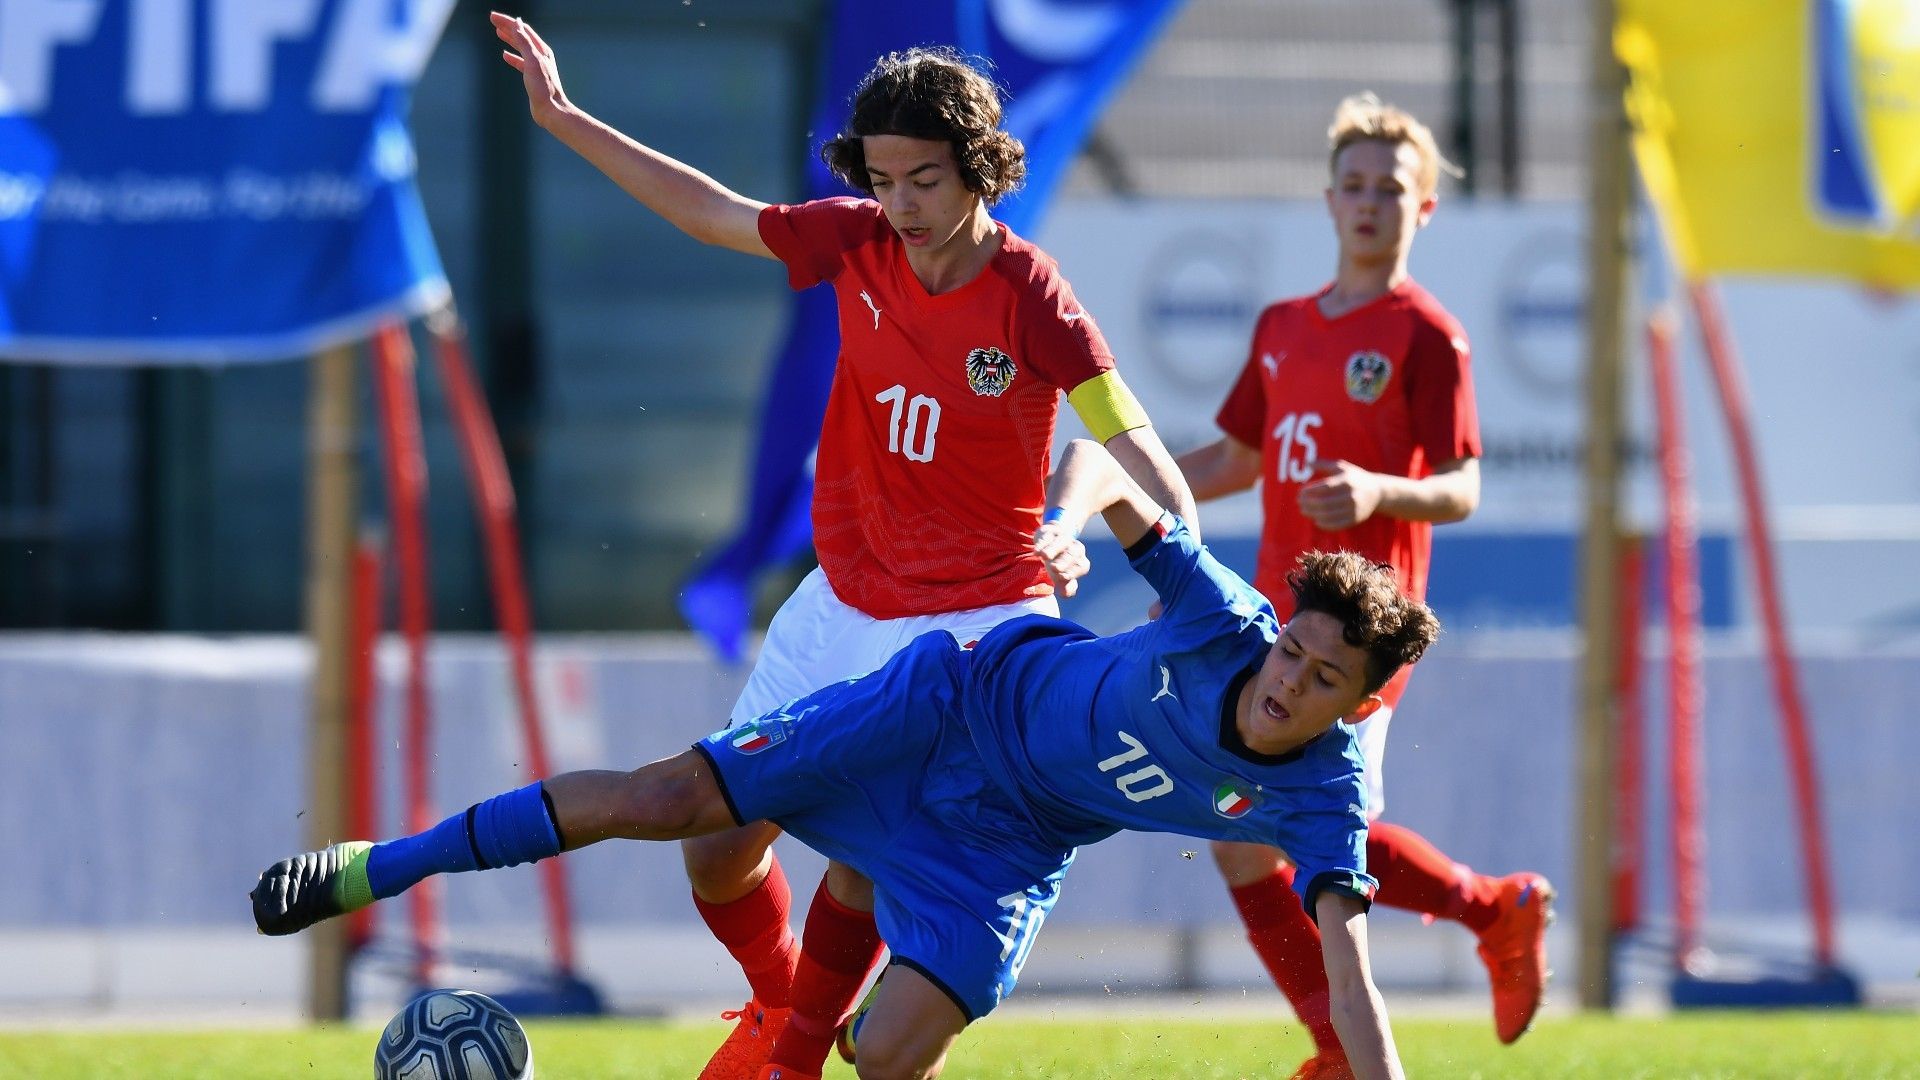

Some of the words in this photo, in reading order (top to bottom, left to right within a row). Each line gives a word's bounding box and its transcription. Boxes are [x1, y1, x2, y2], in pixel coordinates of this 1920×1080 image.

[875, 384, 942, 463] 10
[1273, 412, 1323, 483] 15
[1097, 730, 1174, 803] 10
[997, 891, 1046, 979] 10
